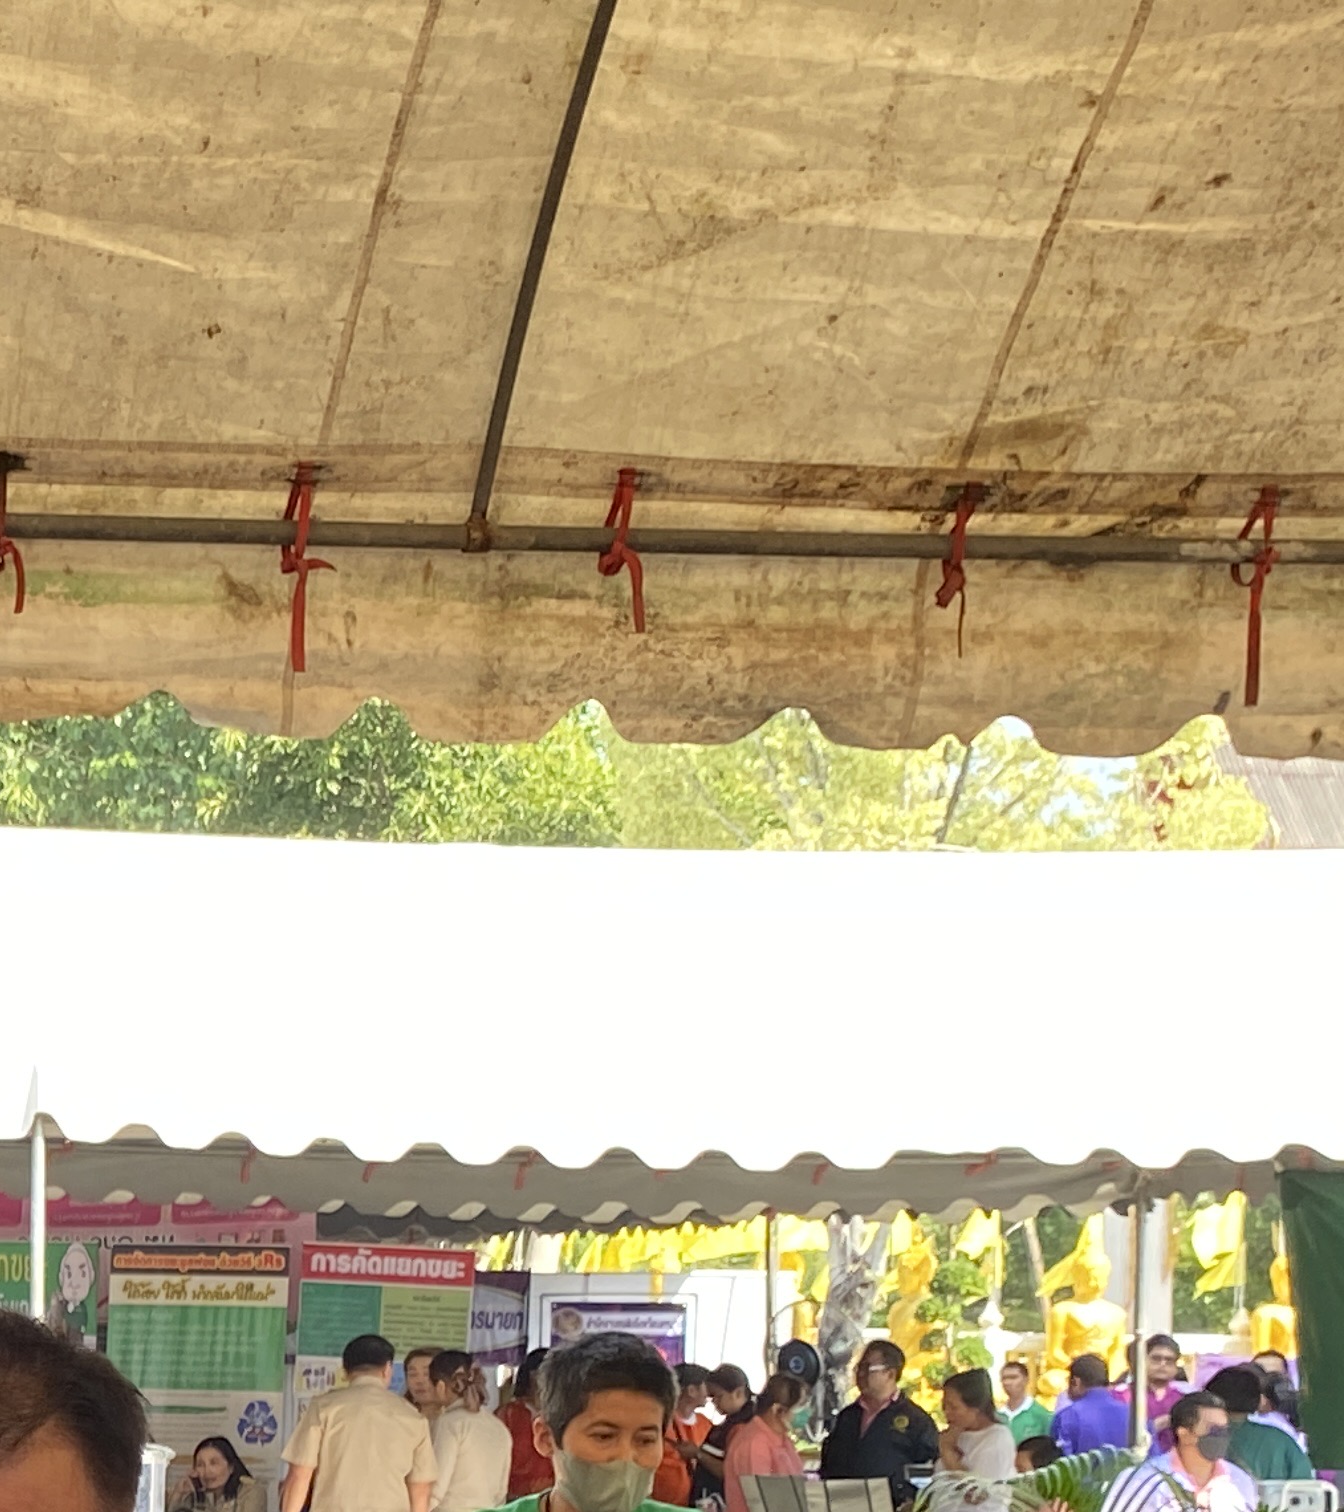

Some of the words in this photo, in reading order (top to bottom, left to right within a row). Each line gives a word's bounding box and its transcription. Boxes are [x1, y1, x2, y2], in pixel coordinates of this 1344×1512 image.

[311, 1248, 466, 1280] การคัดแยกขยะ
[471, 1309, 524, 1330] รนายก
